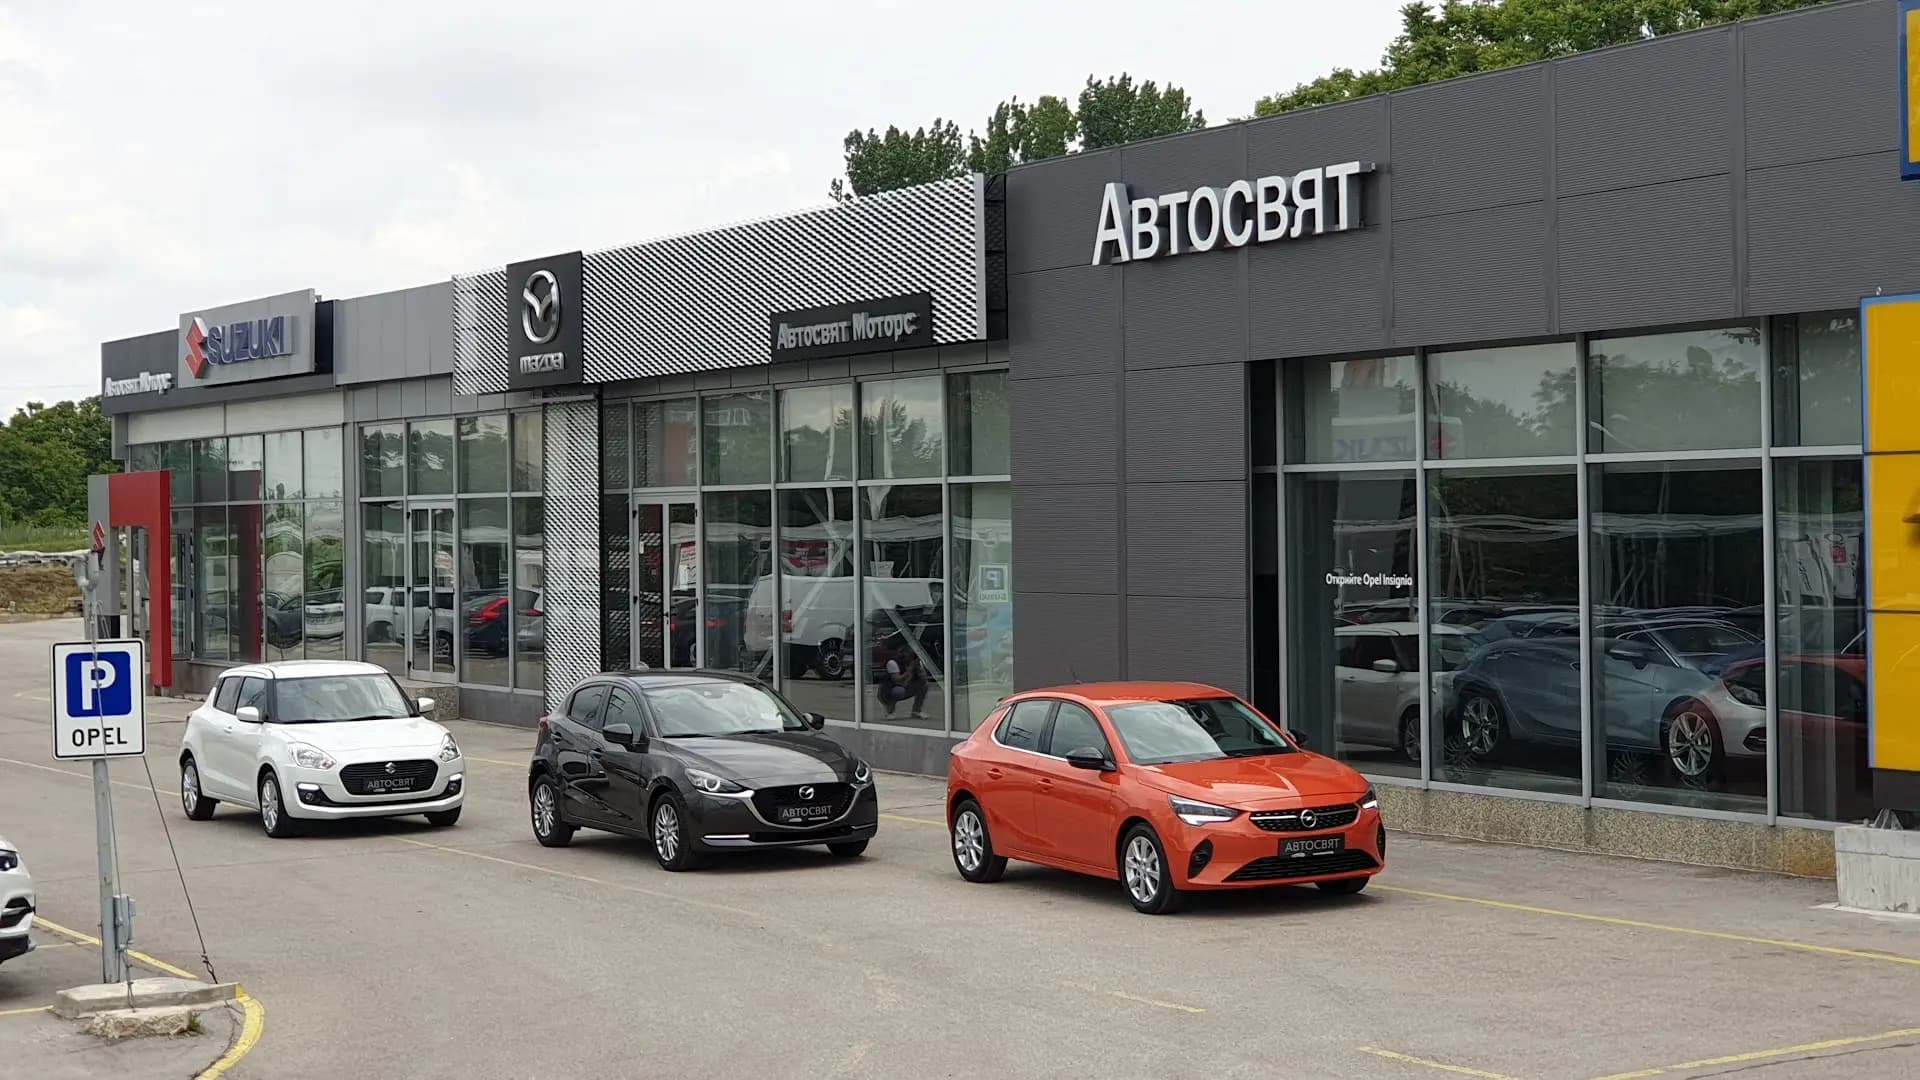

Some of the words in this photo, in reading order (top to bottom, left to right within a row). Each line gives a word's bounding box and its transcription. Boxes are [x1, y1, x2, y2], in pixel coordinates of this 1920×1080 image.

[852, 302, 919, 342] Моторс
[206, 315, 287, 366] SUZUKI
[519, 351, 566, 375] mazda
[1363, 572, 1382, 588] Opel
[1383, 573, 1413, 589] Insignia
[80, 659, 117, 711] P
[71, 727, 129, 747] OPEL
[367, 777, 416, 789] АВТОСВЯТ
[782, 804, 833, 818] АВТОСВЯТ
[1284, 838, 1341, 853] АВТОСВЯТ
